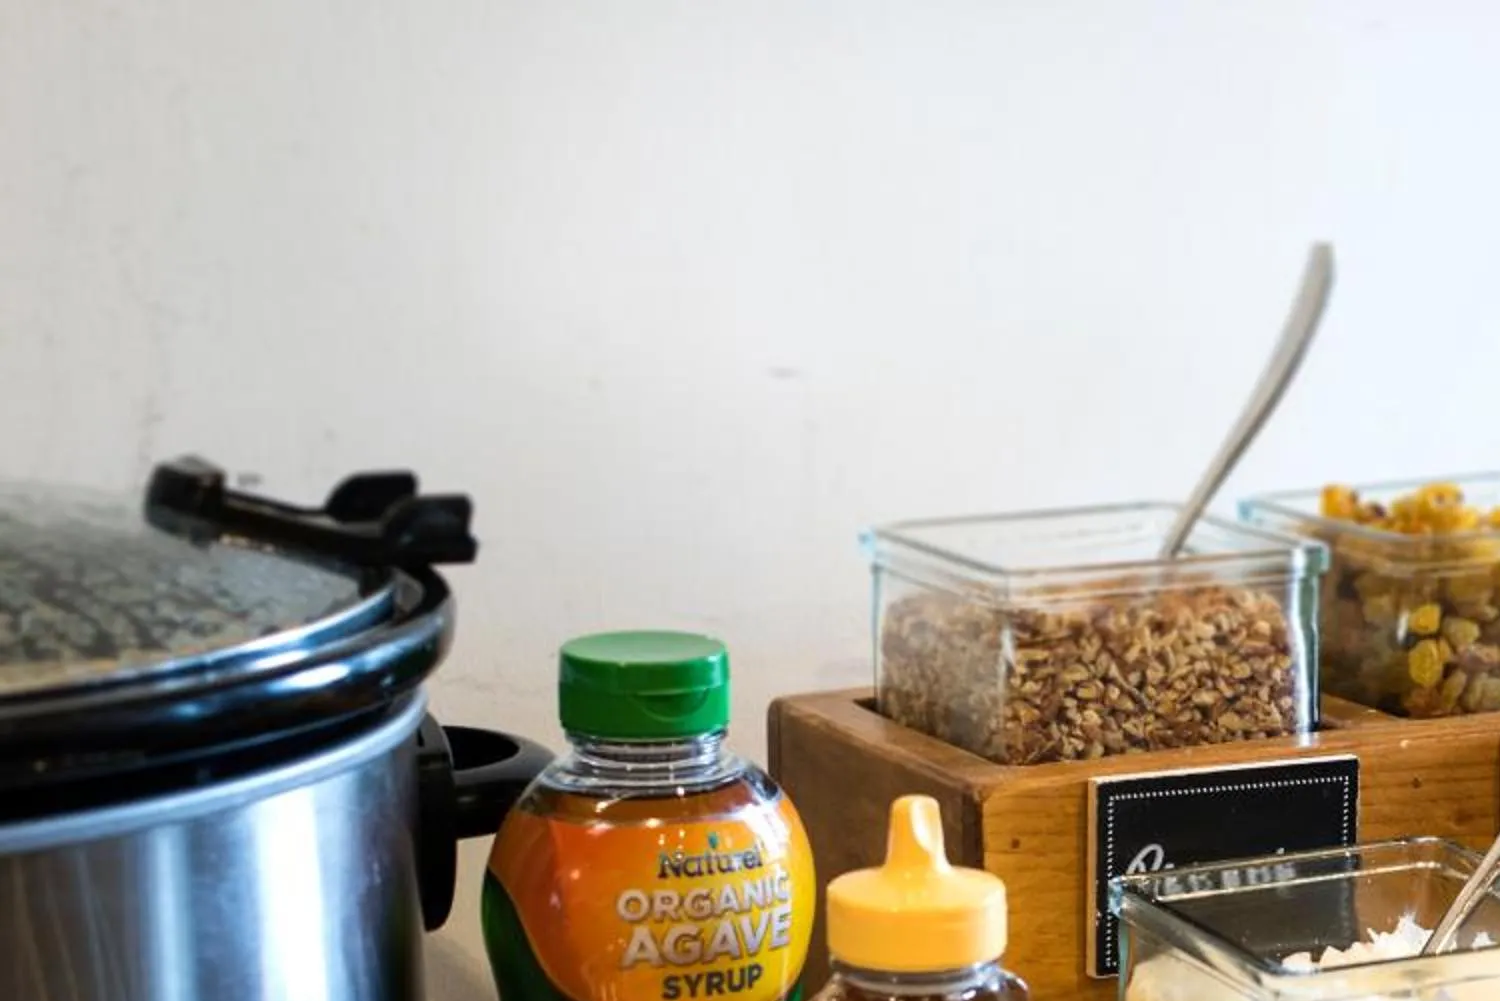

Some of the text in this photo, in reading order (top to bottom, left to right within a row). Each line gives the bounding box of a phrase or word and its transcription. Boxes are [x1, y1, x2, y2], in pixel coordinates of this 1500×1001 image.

[616, 865, 792, 924] ORGANIC
[621, 904, 792, 968] AGAVE
[662, 963, 763, 1000] SYRUP
